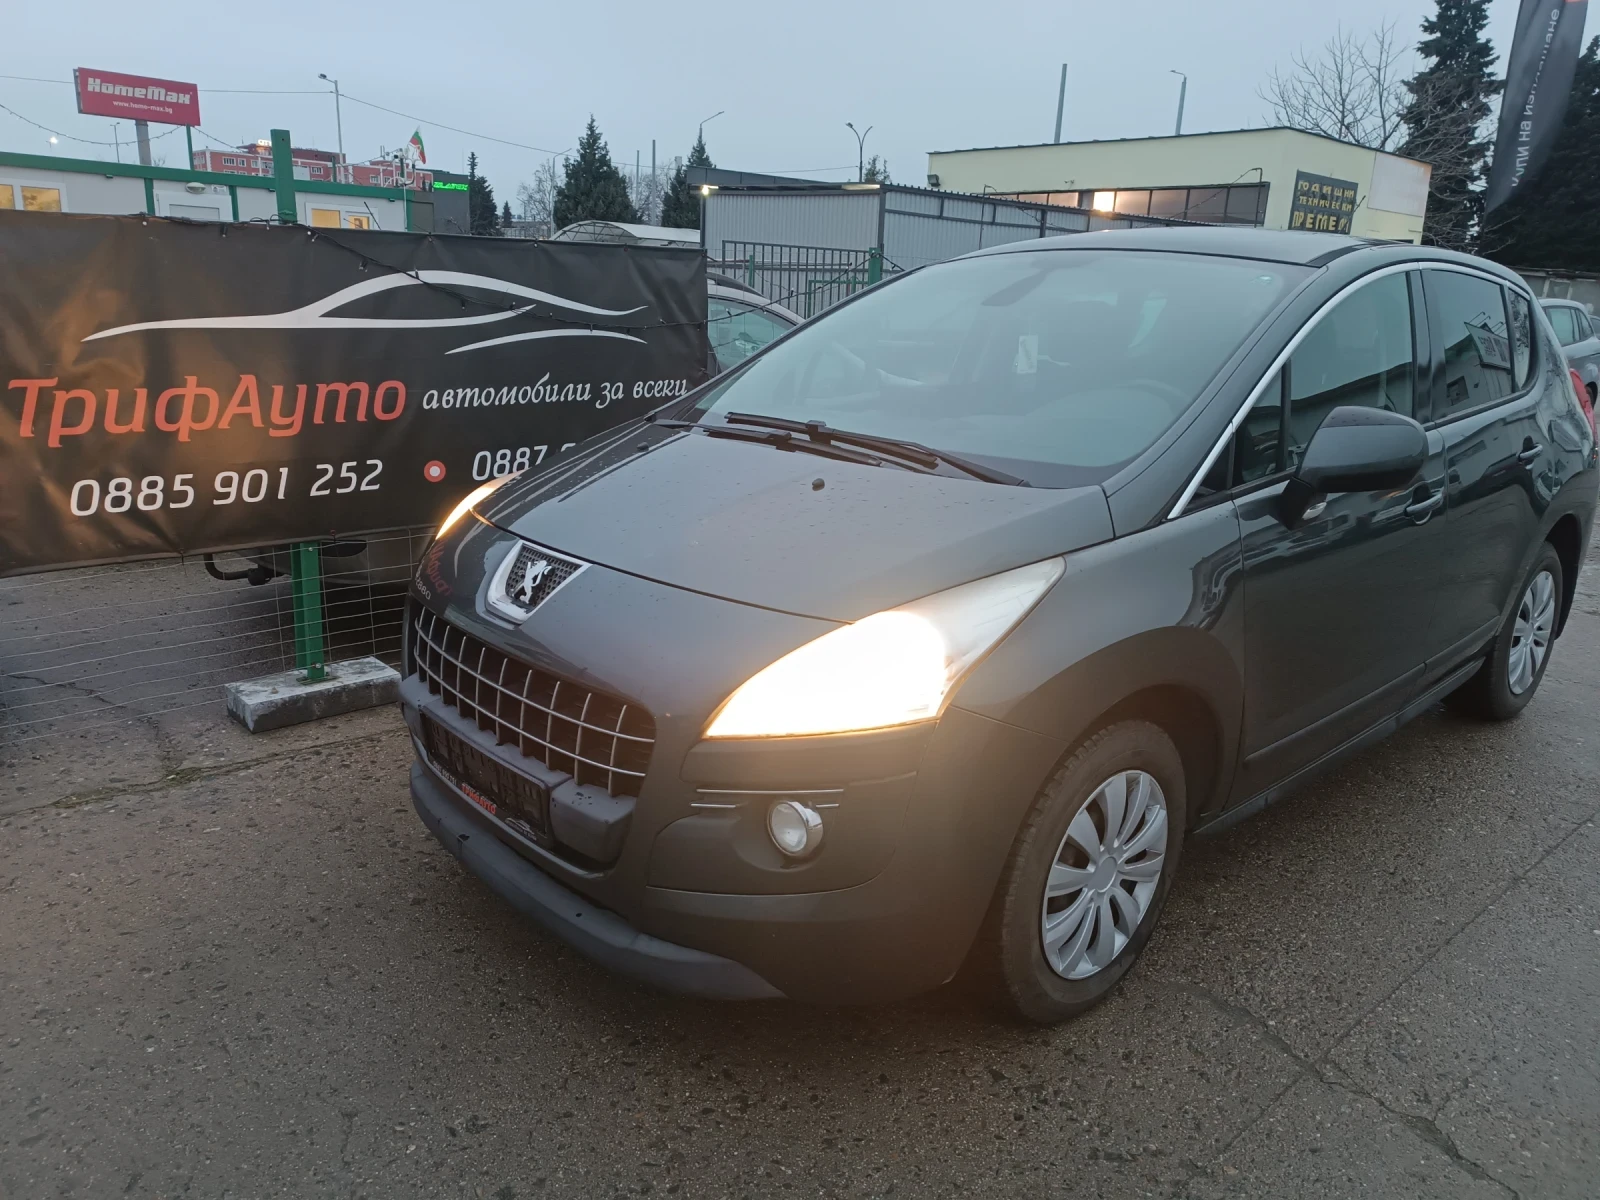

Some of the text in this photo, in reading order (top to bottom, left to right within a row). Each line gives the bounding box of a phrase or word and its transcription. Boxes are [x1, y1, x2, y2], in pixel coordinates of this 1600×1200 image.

[87, 77, 191, 104] HomeMax
[112, 100, 173, 114] www.home-max.bg
[1297, 180, 1354, 198] ГОДИШНИ
[1299, 195, 1352, 212] ТЕХНИЧЕСКИ
[422, 372, 688, 410] автомобили за всеки
[8, 374, 407, 448] ТрифАуто
[472, 445, 548, 481] 0887
[70, 459, 384, 517] 0885 901 252
